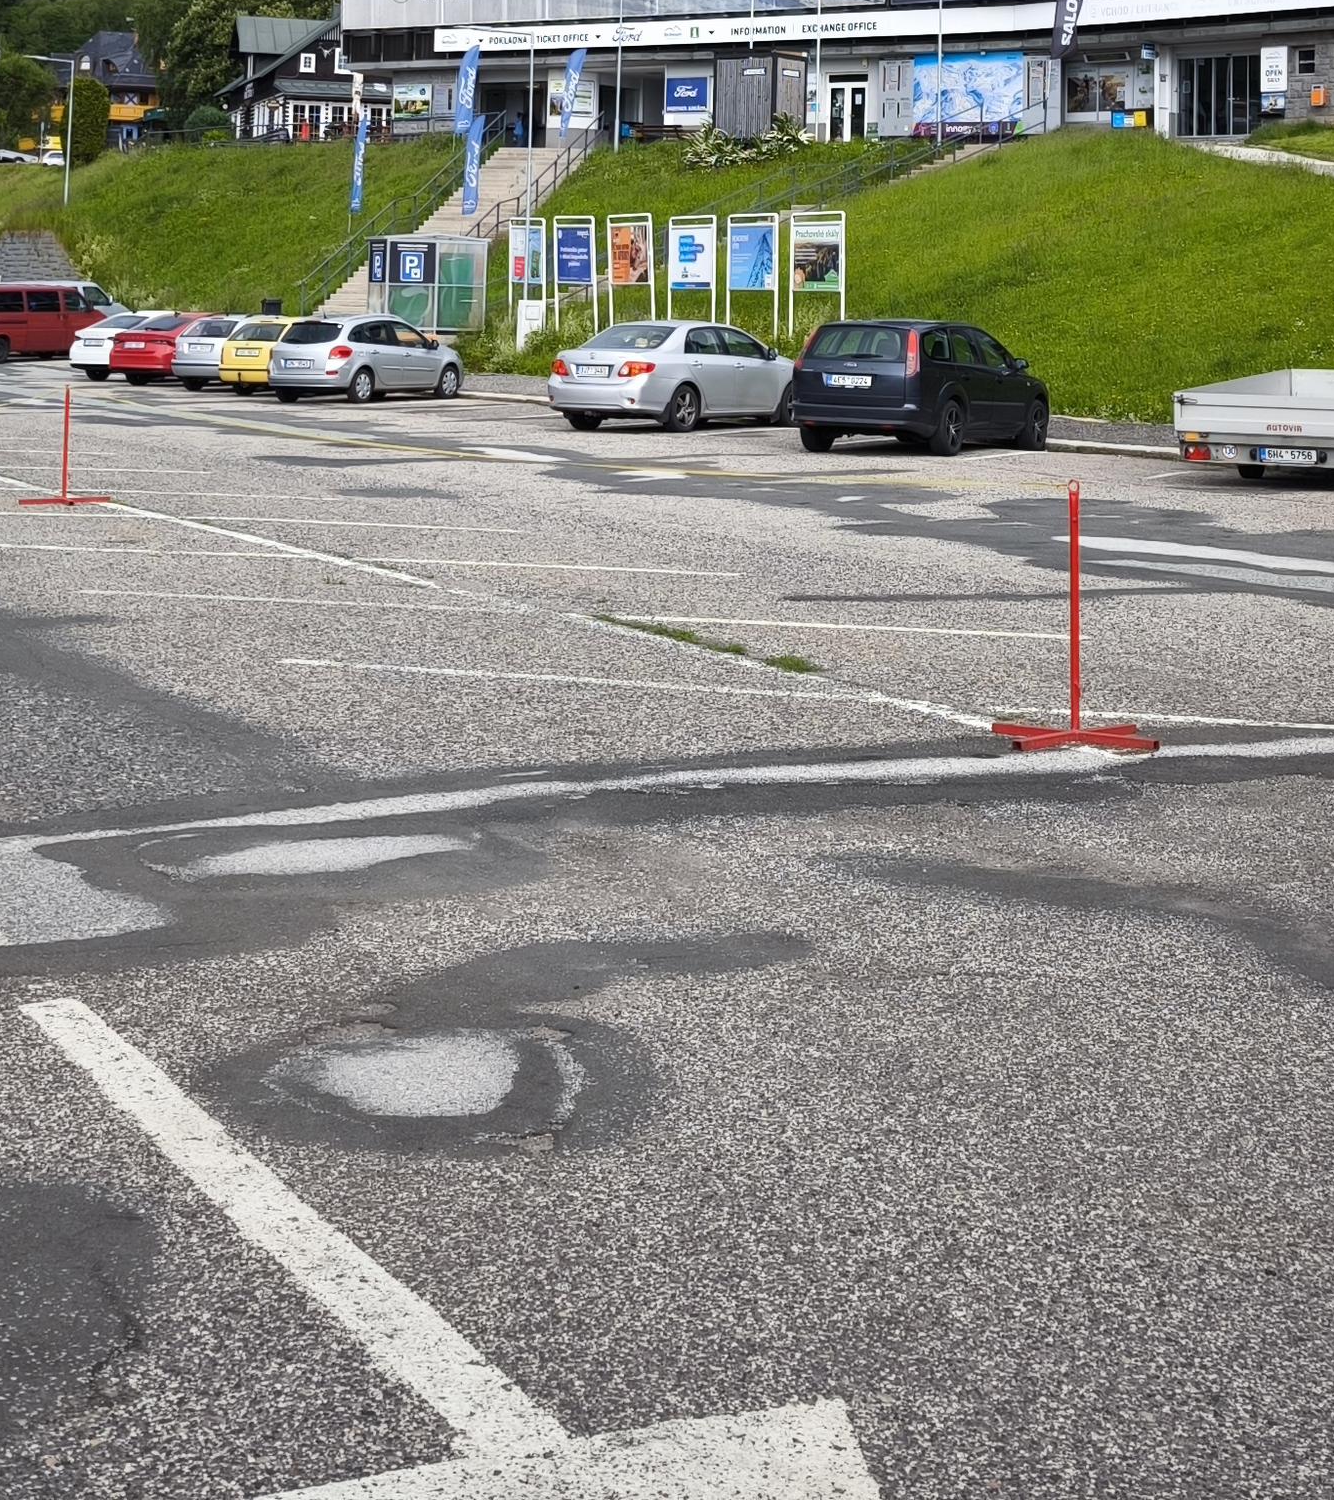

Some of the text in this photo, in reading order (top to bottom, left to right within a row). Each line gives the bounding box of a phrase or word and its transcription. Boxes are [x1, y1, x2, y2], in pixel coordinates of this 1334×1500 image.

[847, 21, 878, 31] OFFICE
[488, 33, 589, 45] POKLADNA TICKET OFFICE
[612, 27, 643, 42] Ford
[458, 66, 476, 110] Ford
[563, 68, 580, 113] Ford
[674, 85, 699, 98] Ford
[405, 255, 419, 275] P
[1224, 446, 1236, 455] 130
[1267, 449, 1313, 461] 6H4 5756
